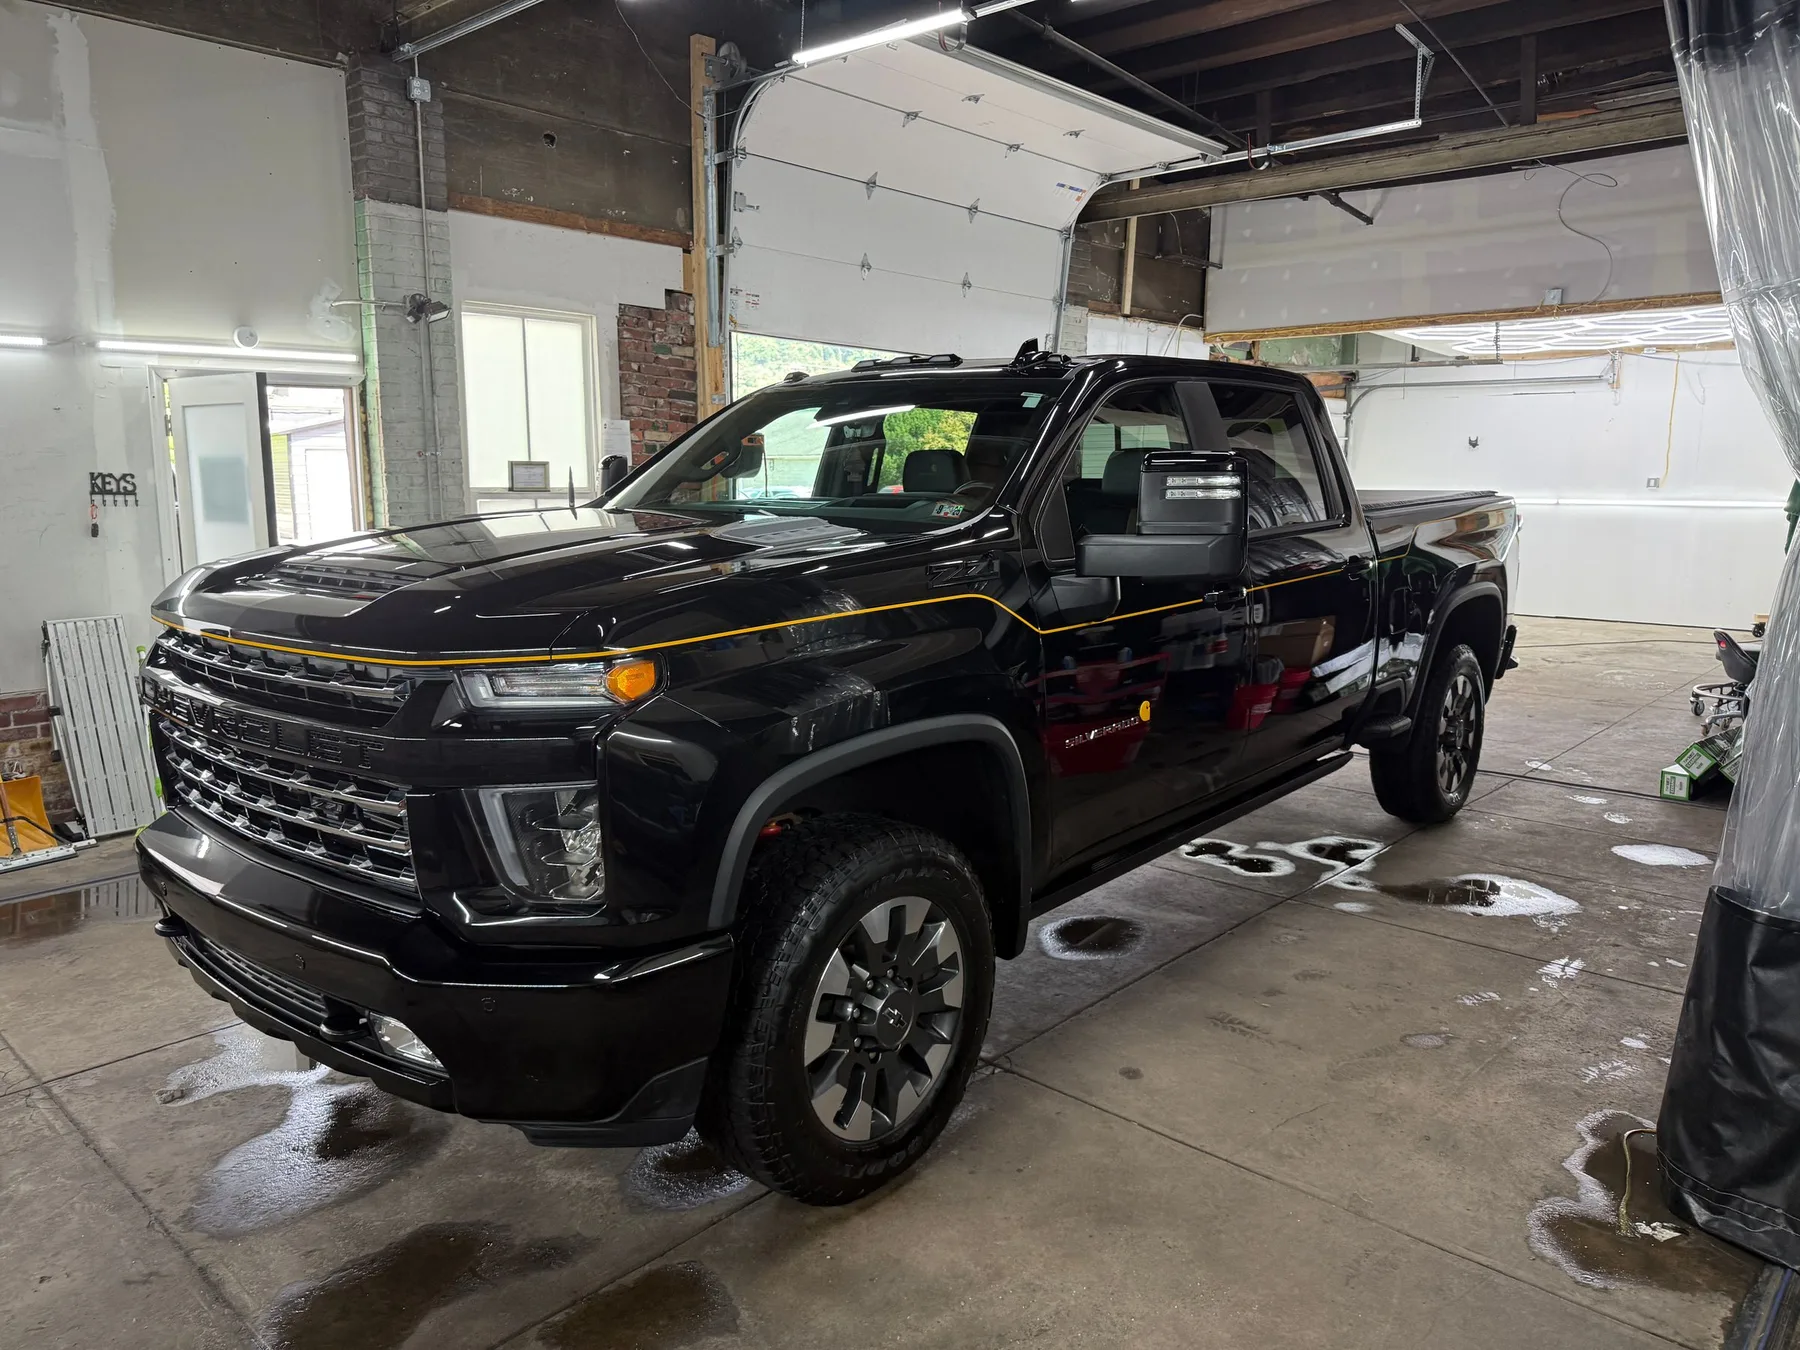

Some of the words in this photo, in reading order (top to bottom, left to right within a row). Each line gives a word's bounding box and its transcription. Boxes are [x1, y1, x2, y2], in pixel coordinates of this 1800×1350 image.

[89, 472, 137, 493] KEYS
[142, 677, 385, 769] CHEVROLET
[1065, 716, 1139, 749] SILVERADO
